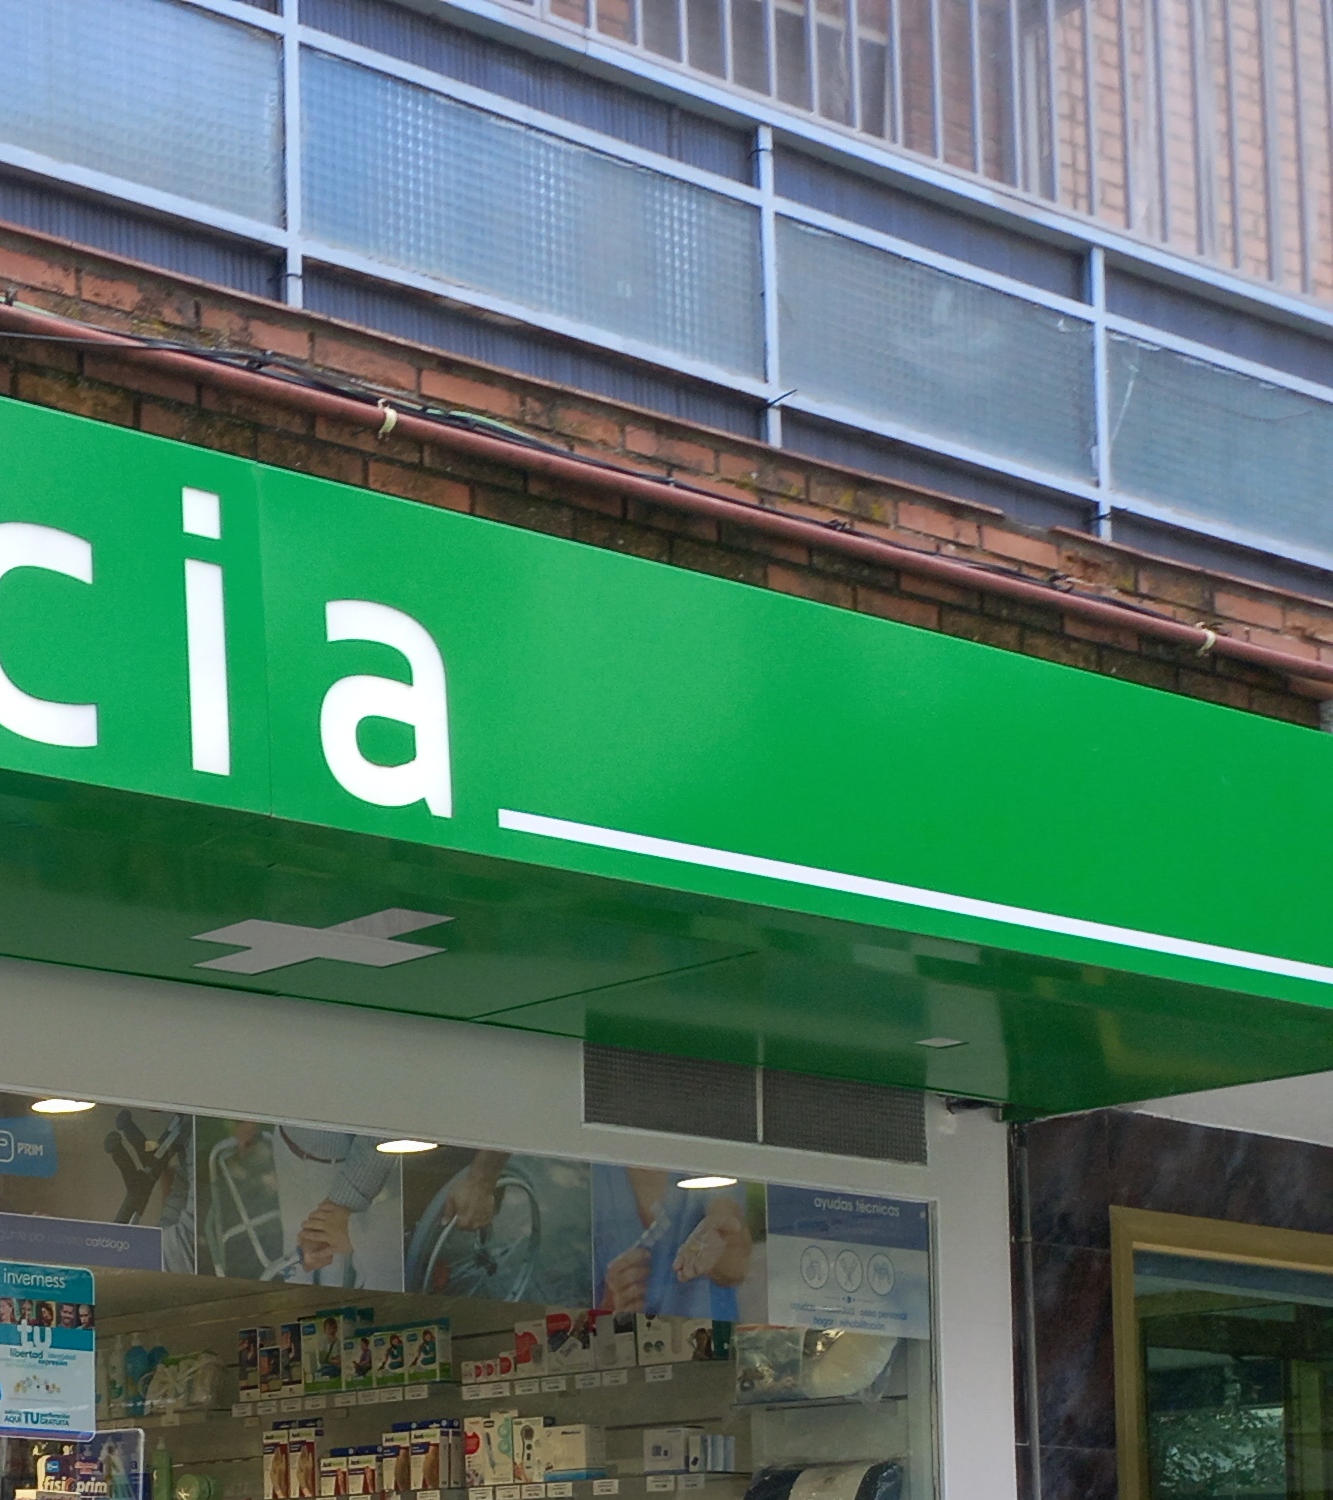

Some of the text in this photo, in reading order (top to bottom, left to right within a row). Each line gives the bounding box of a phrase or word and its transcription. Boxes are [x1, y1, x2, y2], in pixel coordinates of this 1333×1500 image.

[17, 1142, 43, 1156] PRIM
[814, 1196, 900, 1217] ayudas técnicas
[85, 1236, 130, 1252] catálogo
[3, 1268, 66, 1289] inverness
[17, 1318, 52, 1348] tu
[9, 1348, 44, 1360] libertad
[23, 1410, 40, 1425] TU
